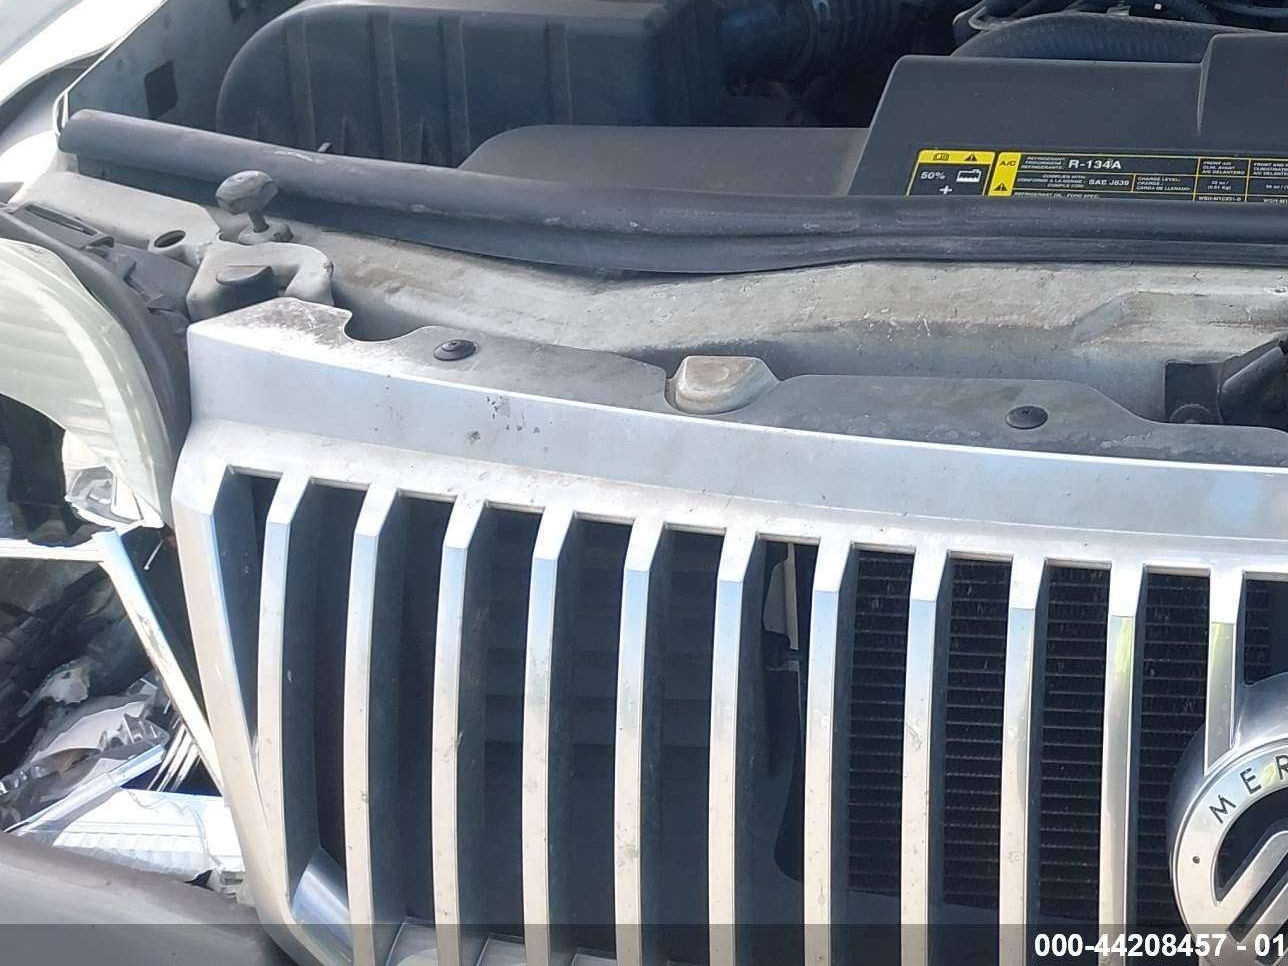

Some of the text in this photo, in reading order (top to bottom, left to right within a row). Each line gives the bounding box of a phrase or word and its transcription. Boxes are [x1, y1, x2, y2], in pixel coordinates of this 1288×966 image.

[1068, 159, 1122, 170] R-134A
[920, 171, 946, 180] 50%
[1088, 178, 1108, 186] SAE
